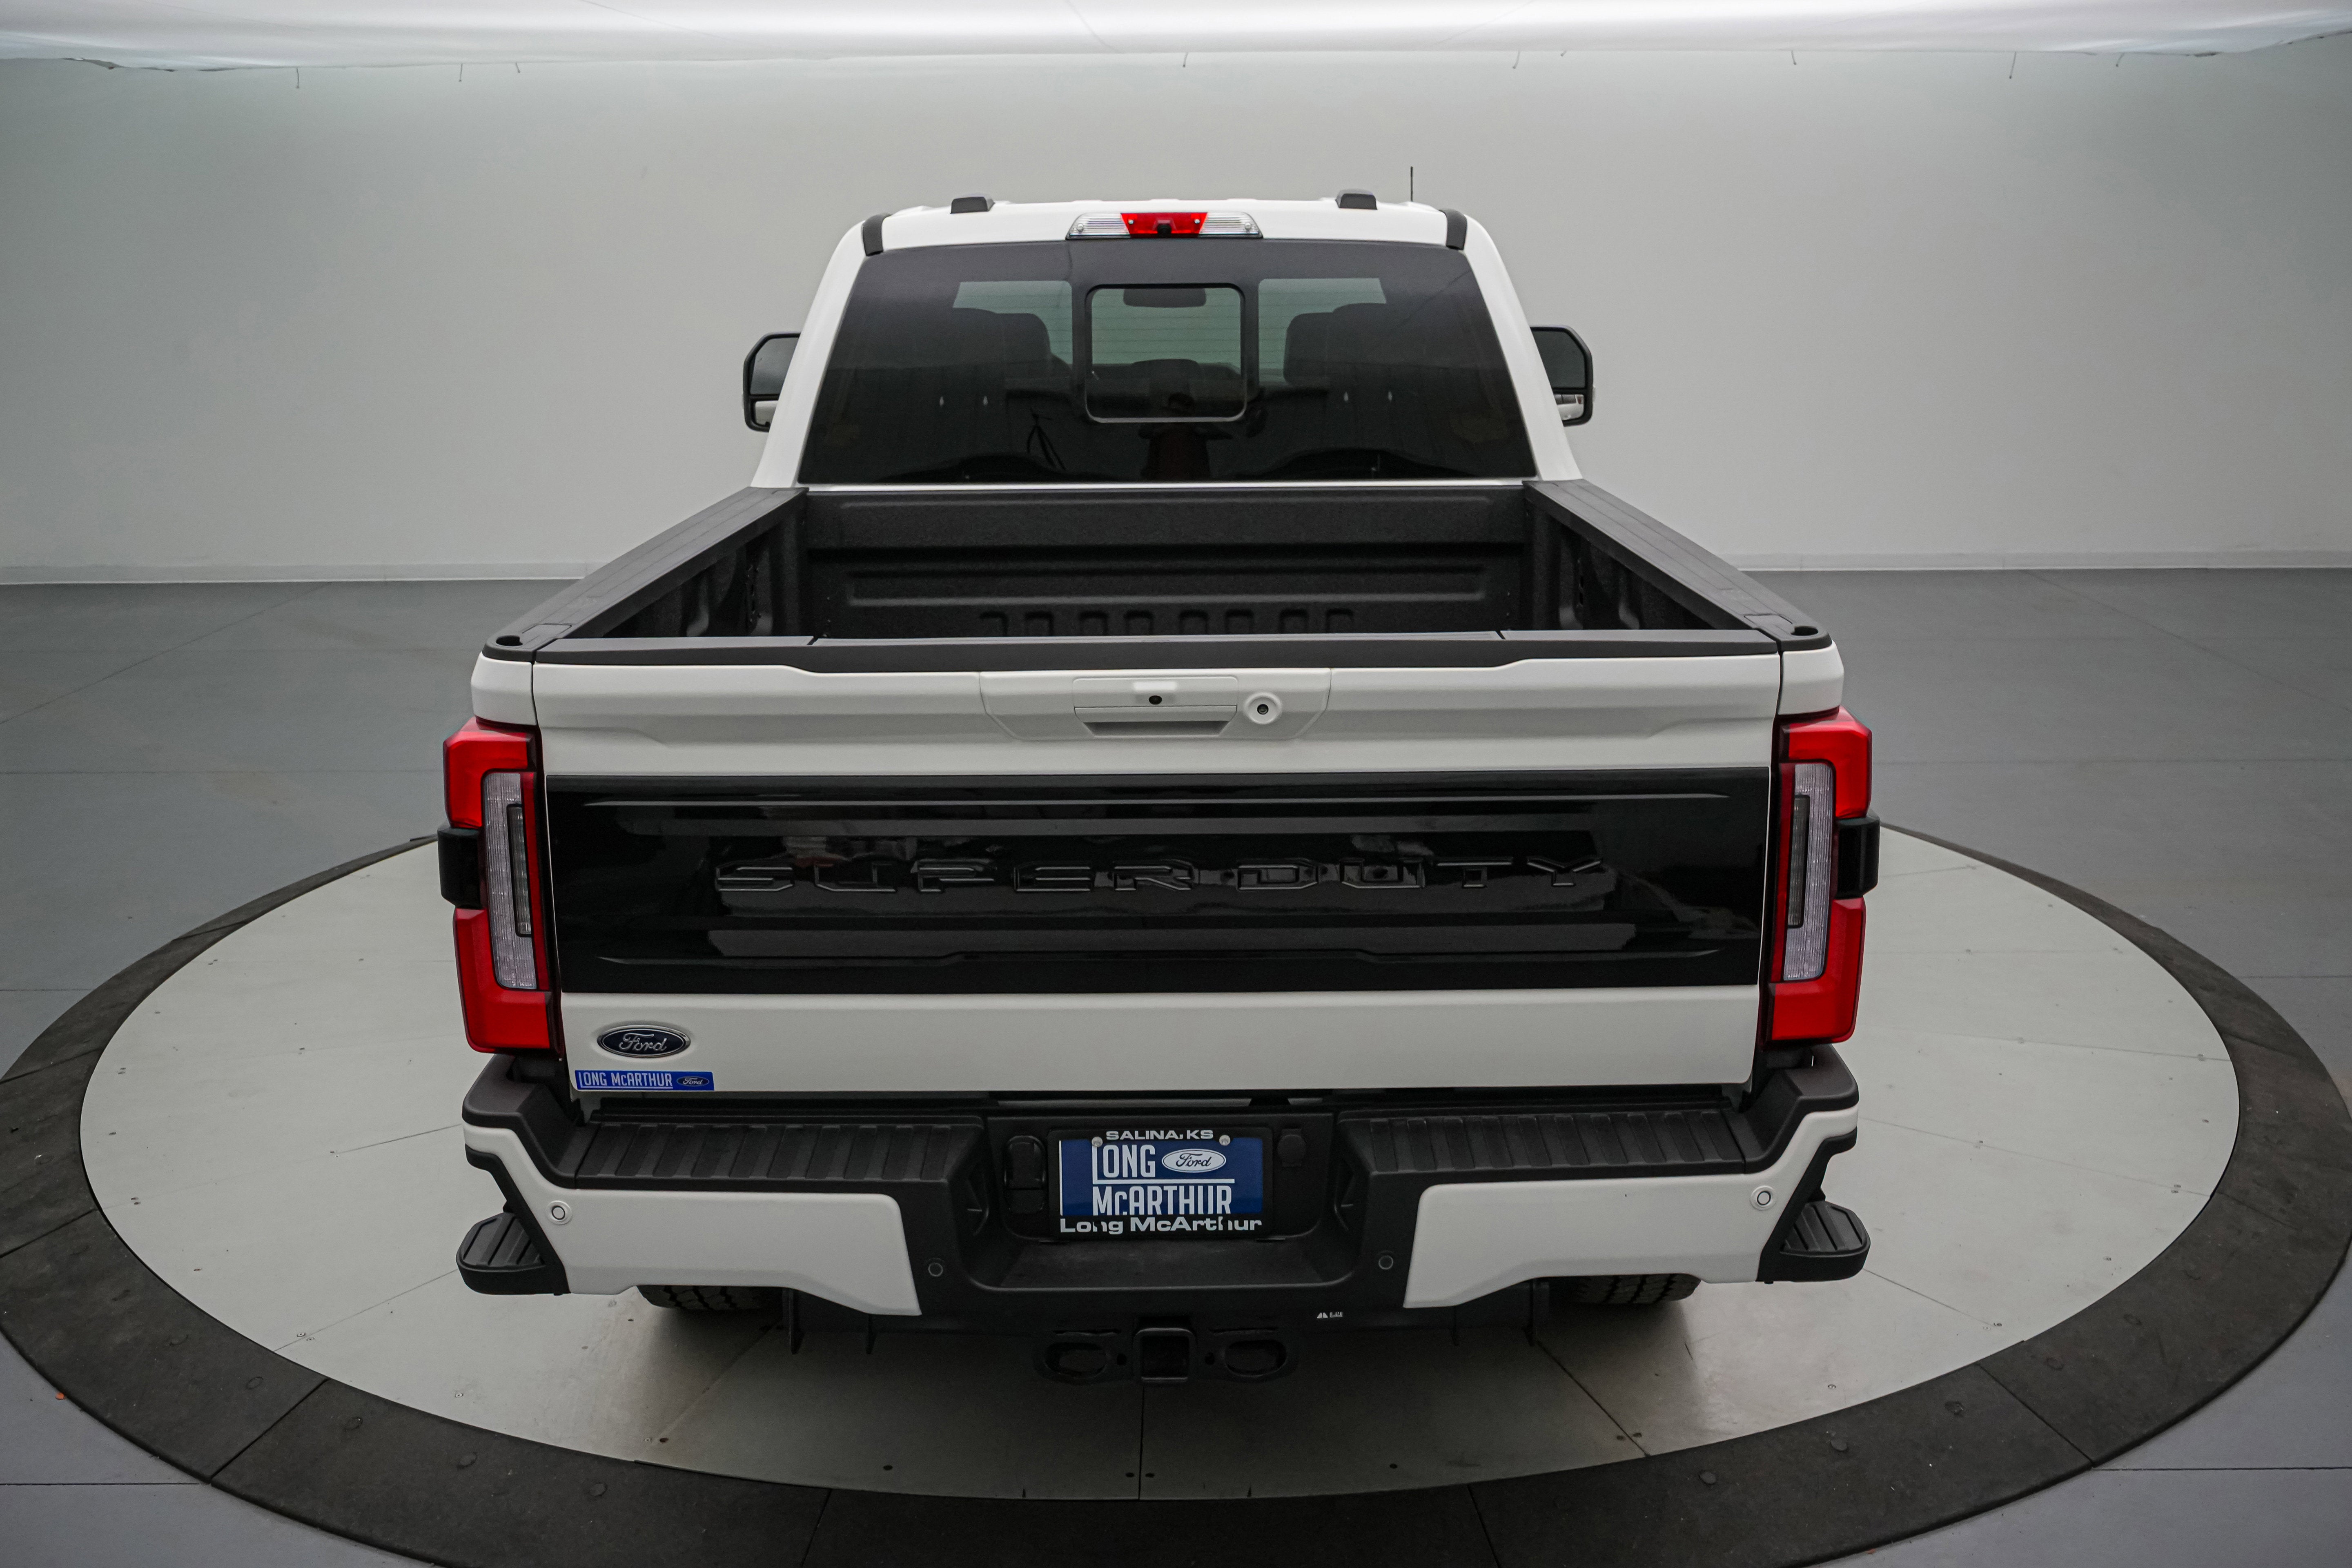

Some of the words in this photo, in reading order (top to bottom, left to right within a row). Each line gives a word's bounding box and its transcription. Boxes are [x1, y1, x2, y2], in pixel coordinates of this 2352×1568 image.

[715, 858, 1194, 892] SUPER
[1236, 856, 1603, 891] DUTY
[619, 1032, 667, 1051] Ford
[578, 1072, 607, 1087] LONG
[611, 1072, 673, 1087] McARTHUR
[682, 1077, 703, 1085] Ford
[1106, 1130, 1183, 1140] SALINA,
[1186, 1129, 1214, 1139] KS
[1092, 1144, 1156, 1183] LONG
[1176, 1153, 1212, 1167] Ford
[1093, 1185, 1232, 1216] McARTHUR
[1060, 1218, 1123, 1234] Long
[1130, 1216, 1262, 1232] McArthur
